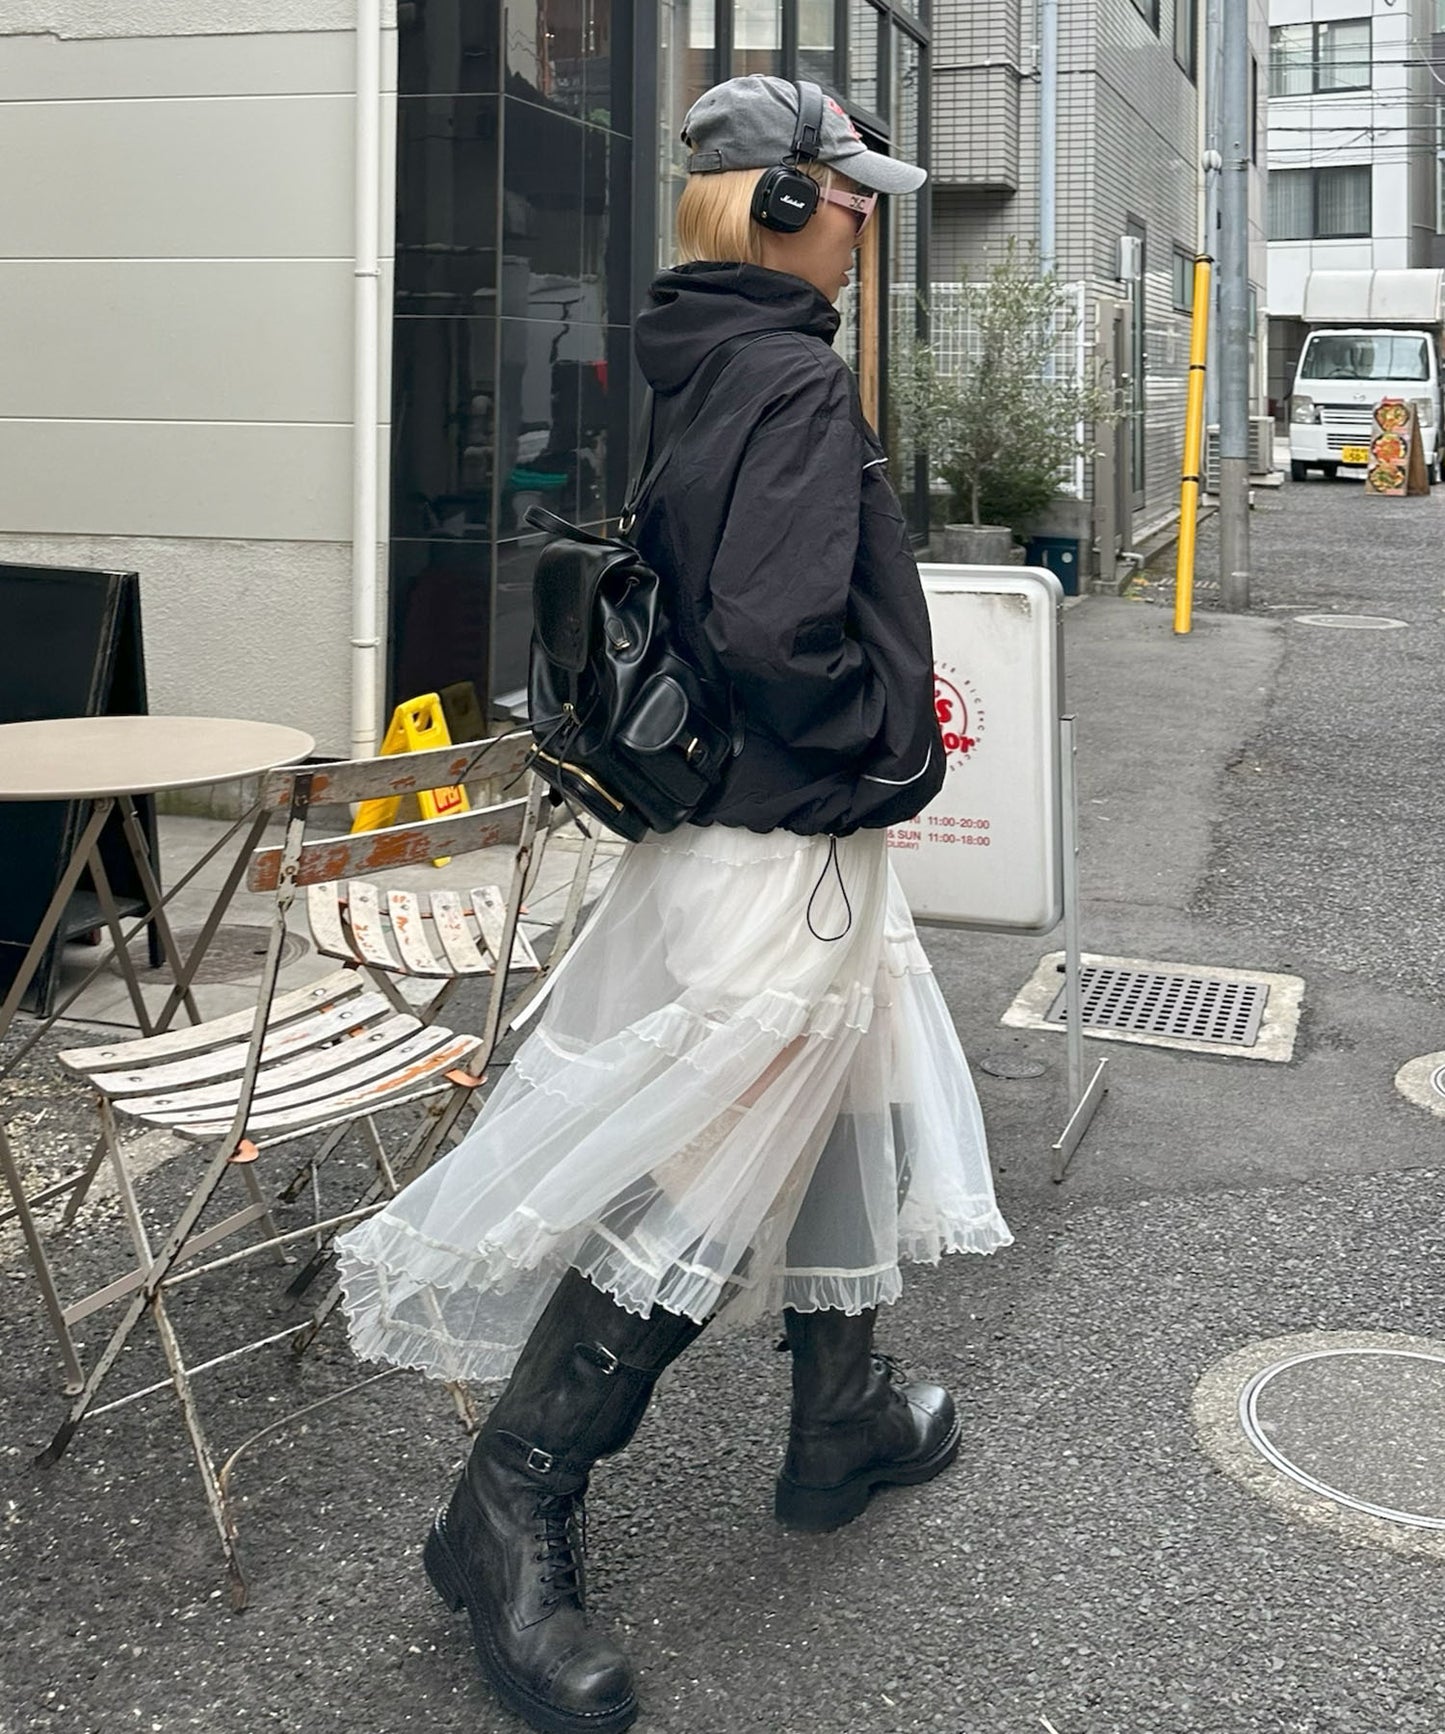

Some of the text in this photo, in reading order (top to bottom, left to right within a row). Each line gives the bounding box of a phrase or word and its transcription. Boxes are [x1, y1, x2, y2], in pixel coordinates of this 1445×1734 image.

[943, 733, 975, 753] or
[928, 816, 990, 829] 11:00-20:00
[897, 830, 921, 840] SUN
[928, 833, 990, 846] 11:00-18:00
